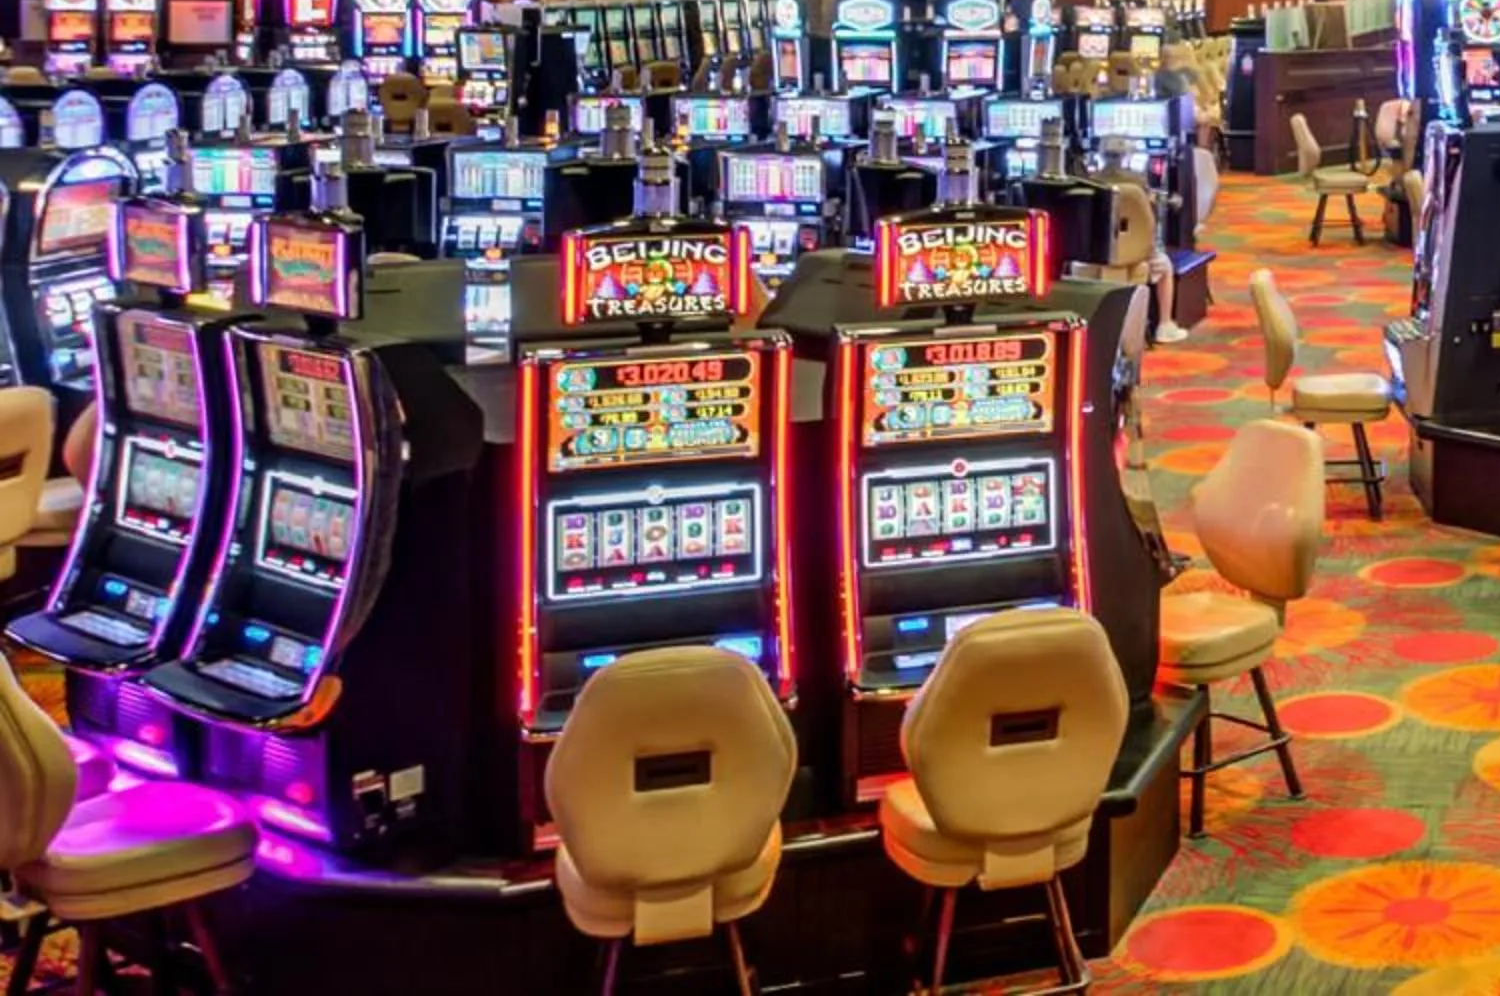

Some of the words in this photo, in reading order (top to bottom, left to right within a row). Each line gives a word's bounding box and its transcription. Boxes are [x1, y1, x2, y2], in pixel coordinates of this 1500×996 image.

[897, 224, 1027, 256] BEIJING
[586, 239, 728, 271] BEIJING
[899, 277, 1026, 301] TREASURES
[585, 293, 726, 317] TREASURES
